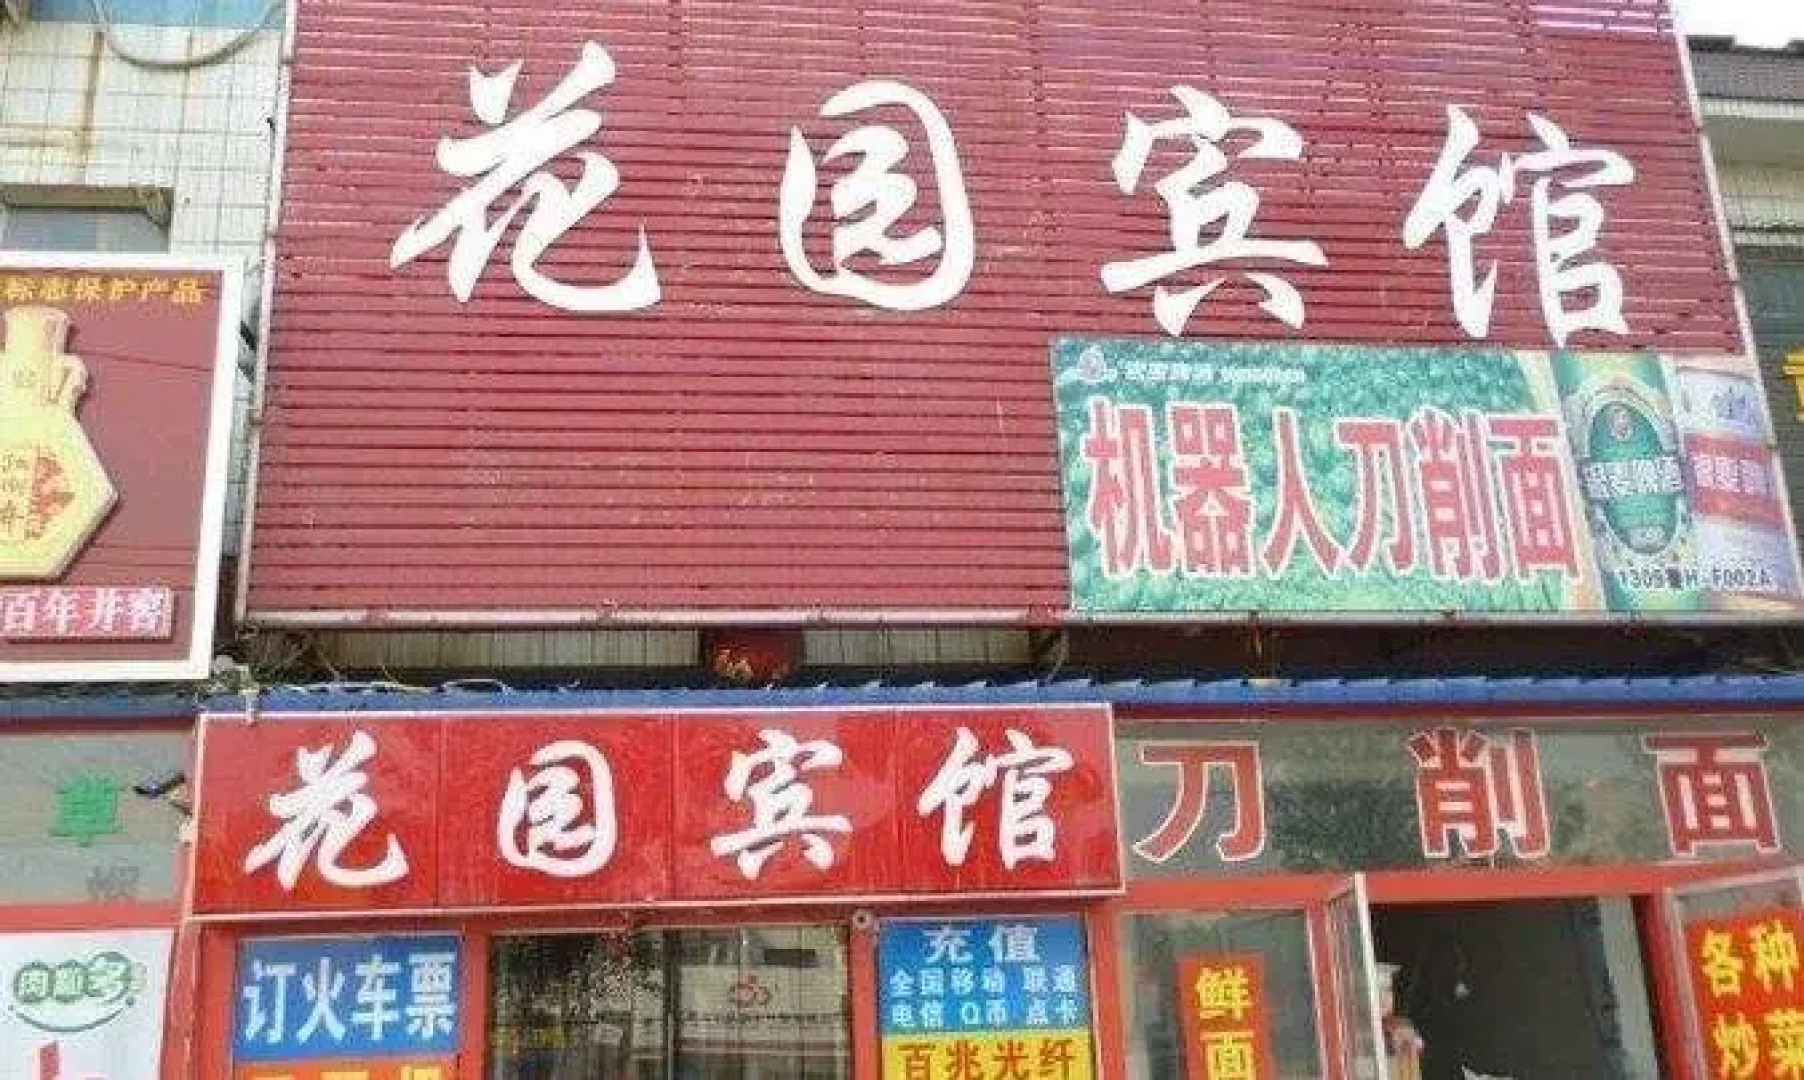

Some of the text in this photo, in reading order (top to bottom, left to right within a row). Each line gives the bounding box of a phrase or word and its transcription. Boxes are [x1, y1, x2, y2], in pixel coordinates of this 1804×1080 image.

[389, 41, 1637, 347] 花园宾馆
[1085, 399, 1580, 580] 机器人刀削面
[244, 726, 1076, 891] 花园宾馆
[1131, 727, 1782, 863] 刀削面
[889, 964, 1077, 998] 全国移动 联通
[921, 925, 1041, 963] 充值
[1702, 920, 1800, 997] 各种
[242, 951, 458, 1044] 订火车票
[891, 993, 1079, 1028] 电信 Q币 点卡
[1195, 966, 1255, 1080] 鲜面
[898, 1040, 1078, 1080] 百兆光纤
